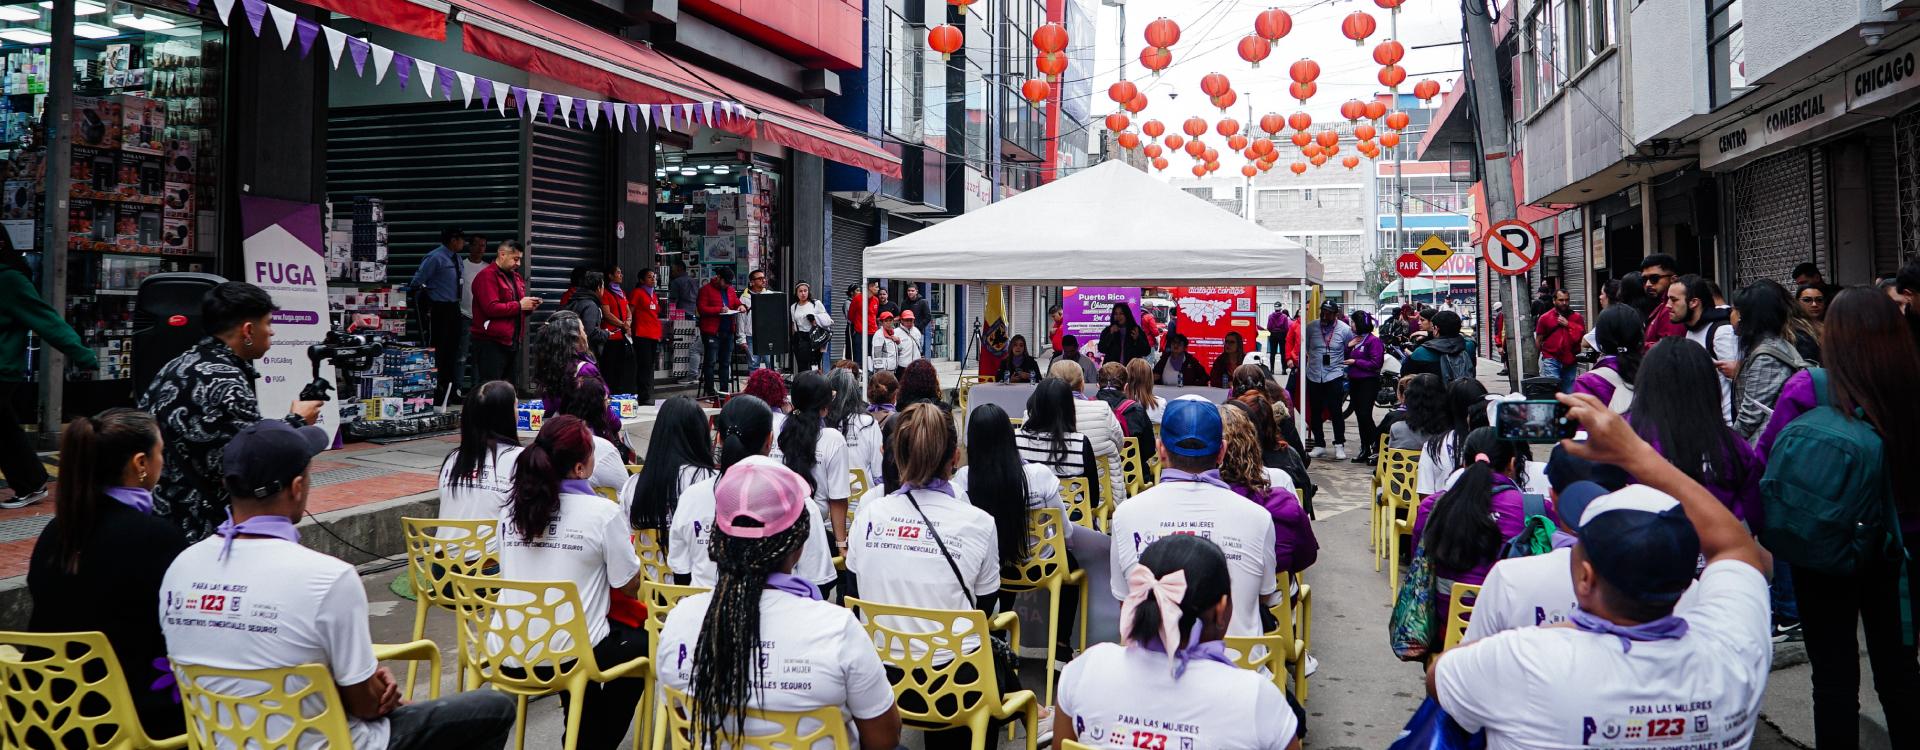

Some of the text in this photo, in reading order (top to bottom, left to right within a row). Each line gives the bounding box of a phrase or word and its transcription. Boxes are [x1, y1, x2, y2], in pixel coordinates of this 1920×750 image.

[1719, 52, 1915, 154] CENTRO COMERCIAL CHICAGO
[1399, 261, 1419, 270] PARE
[1437, 255, 1474, 273] AYOR
[255, 261, 316, 286] FUGA
[1078, 293, 1125, 301] Puerto Rico
[898, 526, 920, 538] 123
[562, 543, 583, 551] SEGUROS
[903, 545, 938, 554] COMERCIALES
[200, 594, 225, 611] 123
[791, 665, 811, 674] MUJER
[780, 681, 811, 690] SEGUROS
[1629, 700, 1712, 714] PARA LAS MUJERES
[1117, 714, 1200, 735] PARA LAS MUJERES
[1647, 717, 1686, 737] 123
[1132, 730, 1168, 750] 123
